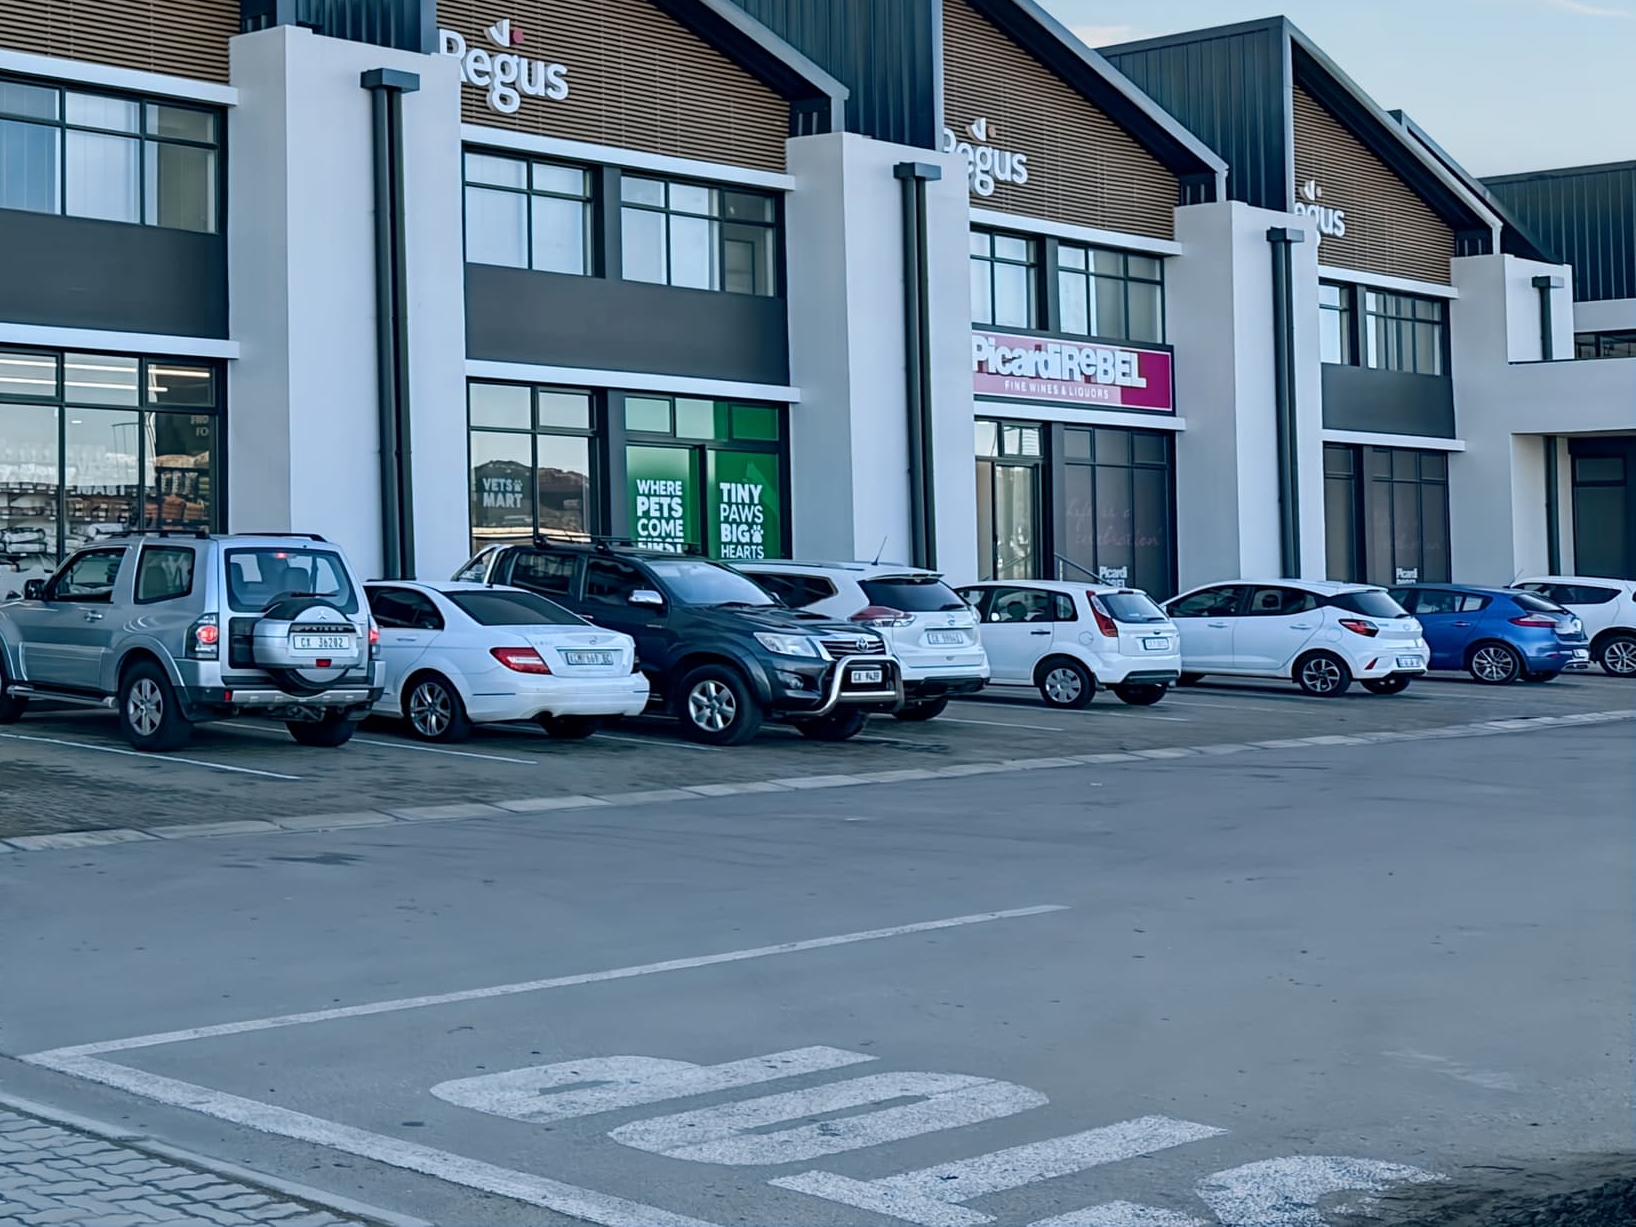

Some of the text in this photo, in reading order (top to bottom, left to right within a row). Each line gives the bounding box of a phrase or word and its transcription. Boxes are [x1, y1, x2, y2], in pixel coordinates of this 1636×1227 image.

[1004, 380, 1027, 392] FINE
[1028, 382, 1059, 396] WINES
[1068, 386, 1109, 400] LIQUORS
[482, 477, 513, 492] VETS
[636, 479, 683, 496] WHERE
[719, 482, 763, 504] TINY
[482, 491, 524, 509] MART
[636, 496, 684, 518] PETS
[720, 503, 764, 523] PAWS
[637, 518, 685, 537] COME
[720, 523, 751, 543] BIG
[721, 544, 765, 559] HEARTS
